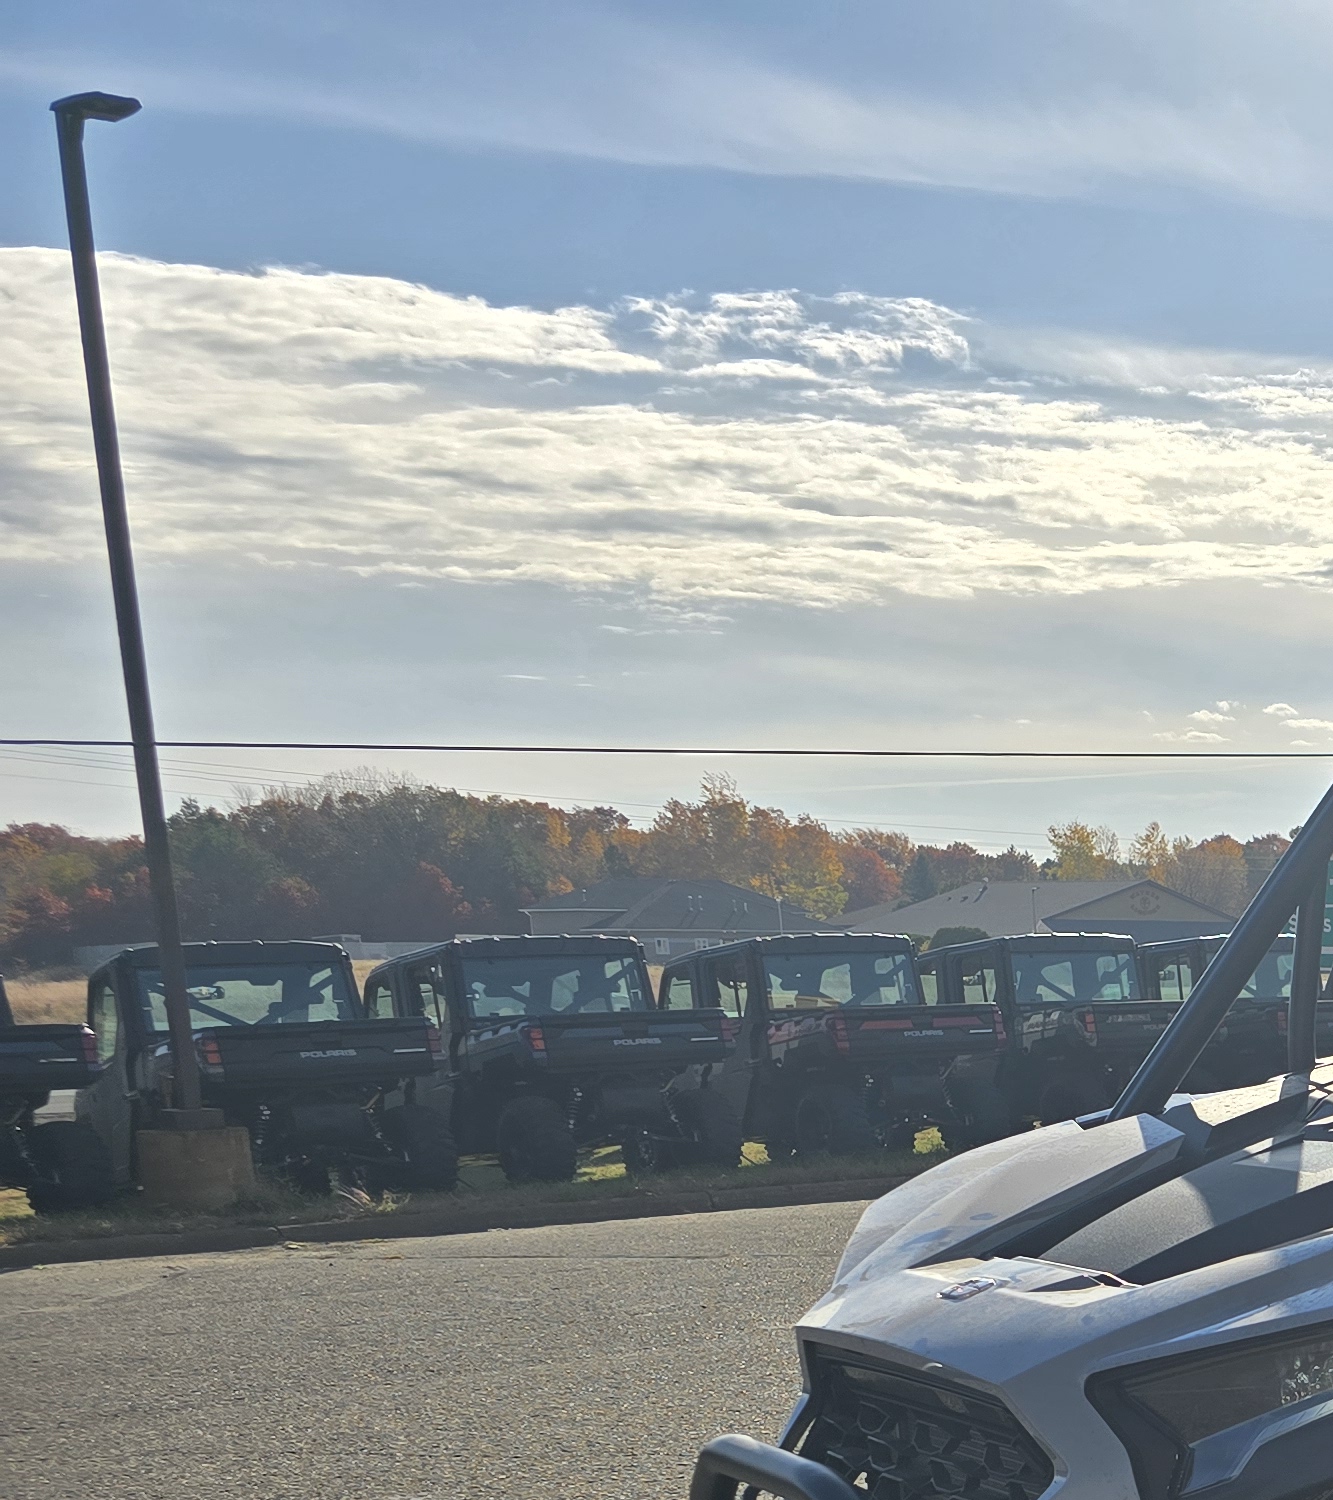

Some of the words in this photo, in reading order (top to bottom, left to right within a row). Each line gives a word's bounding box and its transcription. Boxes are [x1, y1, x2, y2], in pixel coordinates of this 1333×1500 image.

[904, 1029, 944, 1037] POLARIS
[613, 1037, 662, 1046] POLARIS
[300, 1048, 358, 1059] POLARIS
